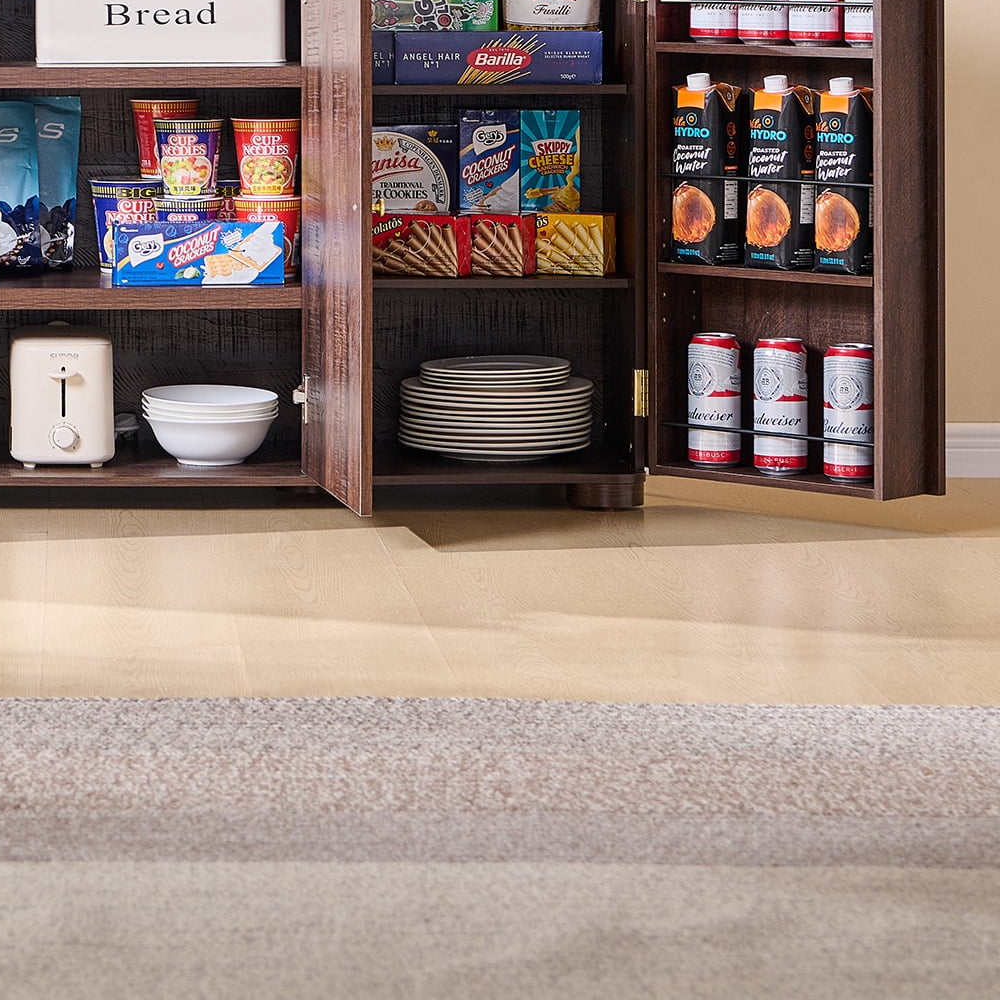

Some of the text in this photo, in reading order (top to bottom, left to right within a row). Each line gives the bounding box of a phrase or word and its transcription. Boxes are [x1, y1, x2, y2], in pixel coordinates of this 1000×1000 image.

[103, 1, 217, 26] Bread
[533, 4, 572, 16] Fusilli
[403, 52, 460, 60] ANGEL HAIR
[474, 52, 524, 66] Barilla
[252, 134, 282, 145] CUP
[674, 127, 710, 139] HYDRO
[750, 128, 788, 141] HYDRO
[816, 132, 855, 144] HYDRO
[169, 135, 197, 146] CUP
[161, 145, 207, 156] NOODLES
[243, 144, 289, 155] NOODLES
[536, 141, 572, 156] SKIPPY
[673, 148, 712, 163] Coconut
[372, 150, 423, 174] anisa
[462, 144, 516, 179] COCONUT
[528, 153, 574, 169] CHEESE
[675, 160, 708, 174] Water
[467, 160, 509, 186] CRACKERS
[751, 163, 784, 177] Water
[817, 165, 852, 181] Water
[118, 187, 156, 198] BIG
[383, 188, 428, 199] COOKIES
[118, 200, 153, 213] CUP
[106, 212, 157, 224] NOODLE
[168, 226, 222, 261] COCONUT
[174, 242, 215, 267] CRACKERS
[823, 417, 873, 436] Budweise
